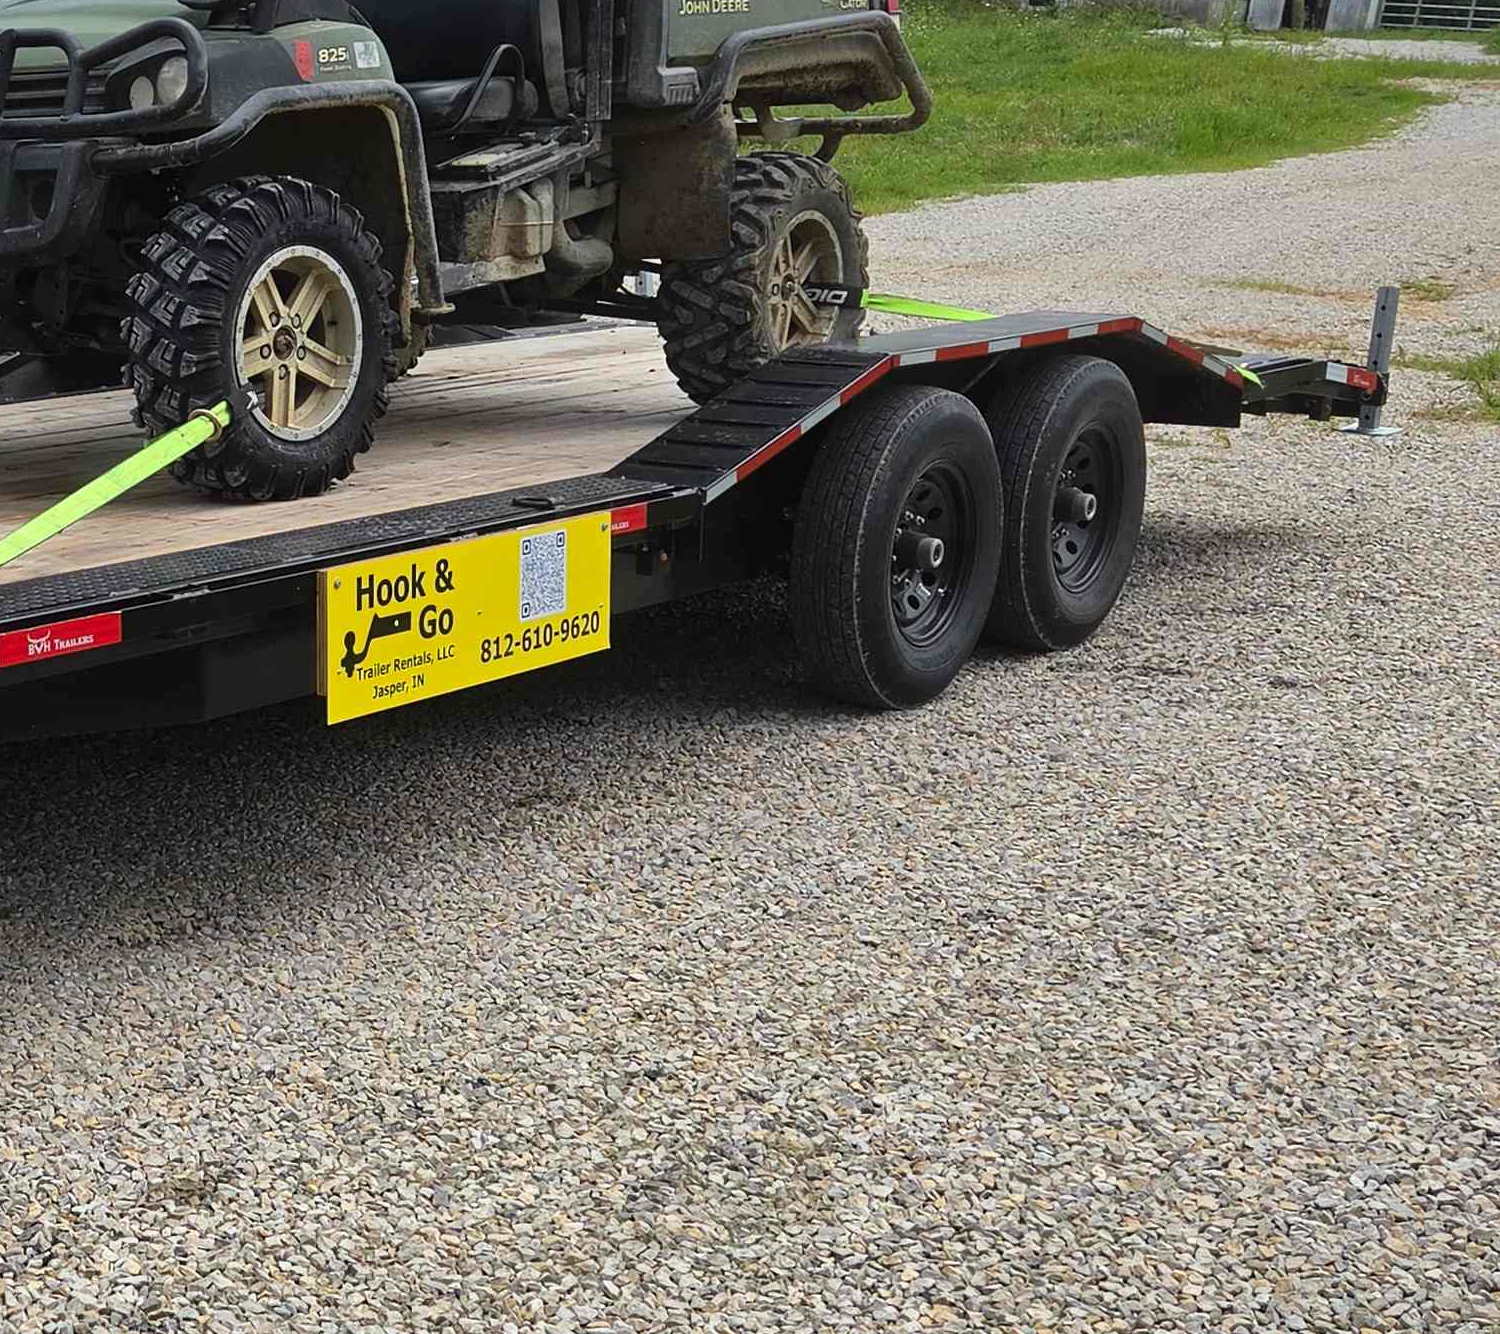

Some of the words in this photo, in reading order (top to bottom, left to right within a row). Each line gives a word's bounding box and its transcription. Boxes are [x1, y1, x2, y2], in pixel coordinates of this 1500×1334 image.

[679, 0, 710, 15] JOHN
[356, 564, 426, 612] Hook
[435, 558, 455, 593] &
[418, 604, 454, 639] Go
[480, 611, 600, 663] 812-610-9620
[356, 659, 391, 682] Trailer
[393, 650, 434, 674] Rentals,
[437, 645, 455, 661] LLC
[372, 678, 409, 700] Jasper,
[412, 674, 425, 688] IN
